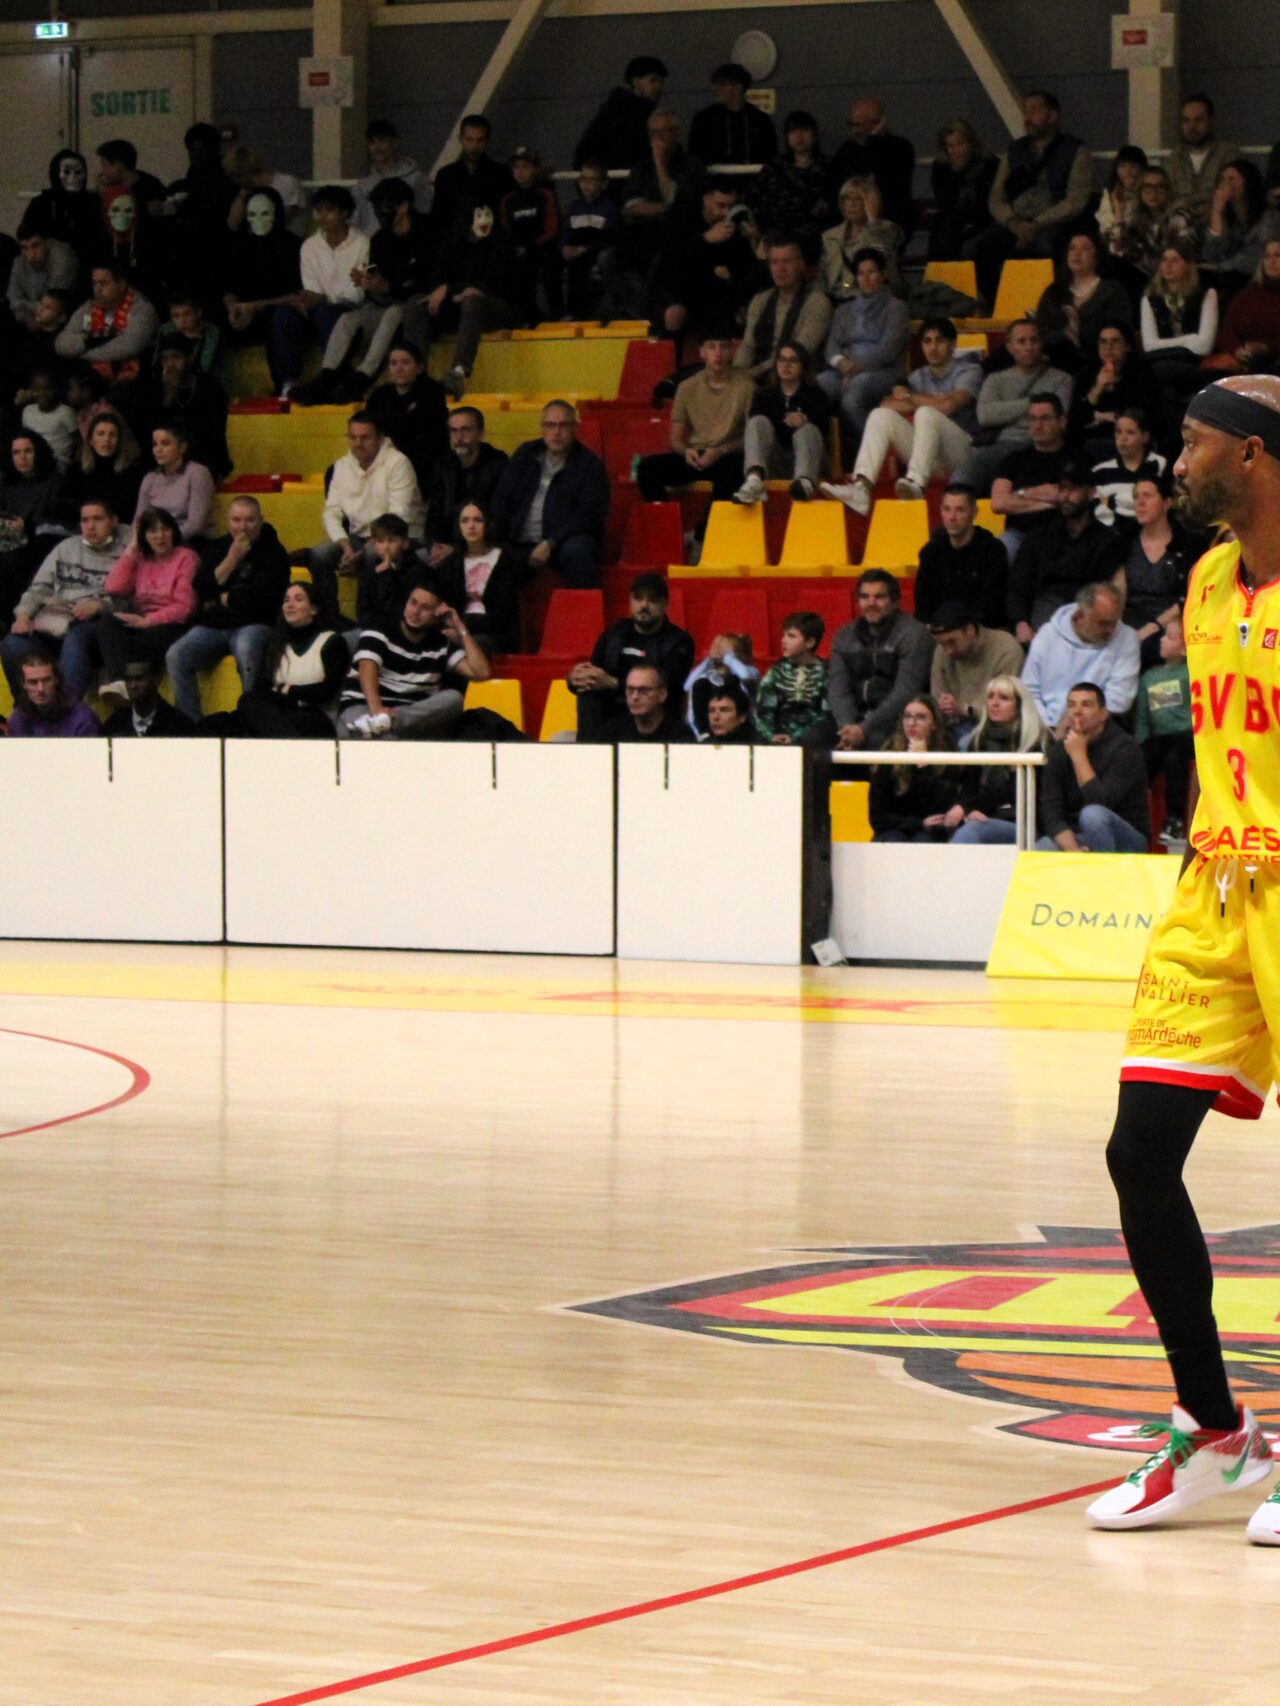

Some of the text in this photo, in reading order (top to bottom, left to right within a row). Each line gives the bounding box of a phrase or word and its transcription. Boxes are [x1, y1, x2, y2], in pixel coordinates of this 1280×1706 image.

[91, 88, 170, 117] SORTIE
[1227, 748, 1245, 802] 3
[1031, 903, 1161, 930] DOMAIN
[1141, 988, 1210, 1008] VALLIER
